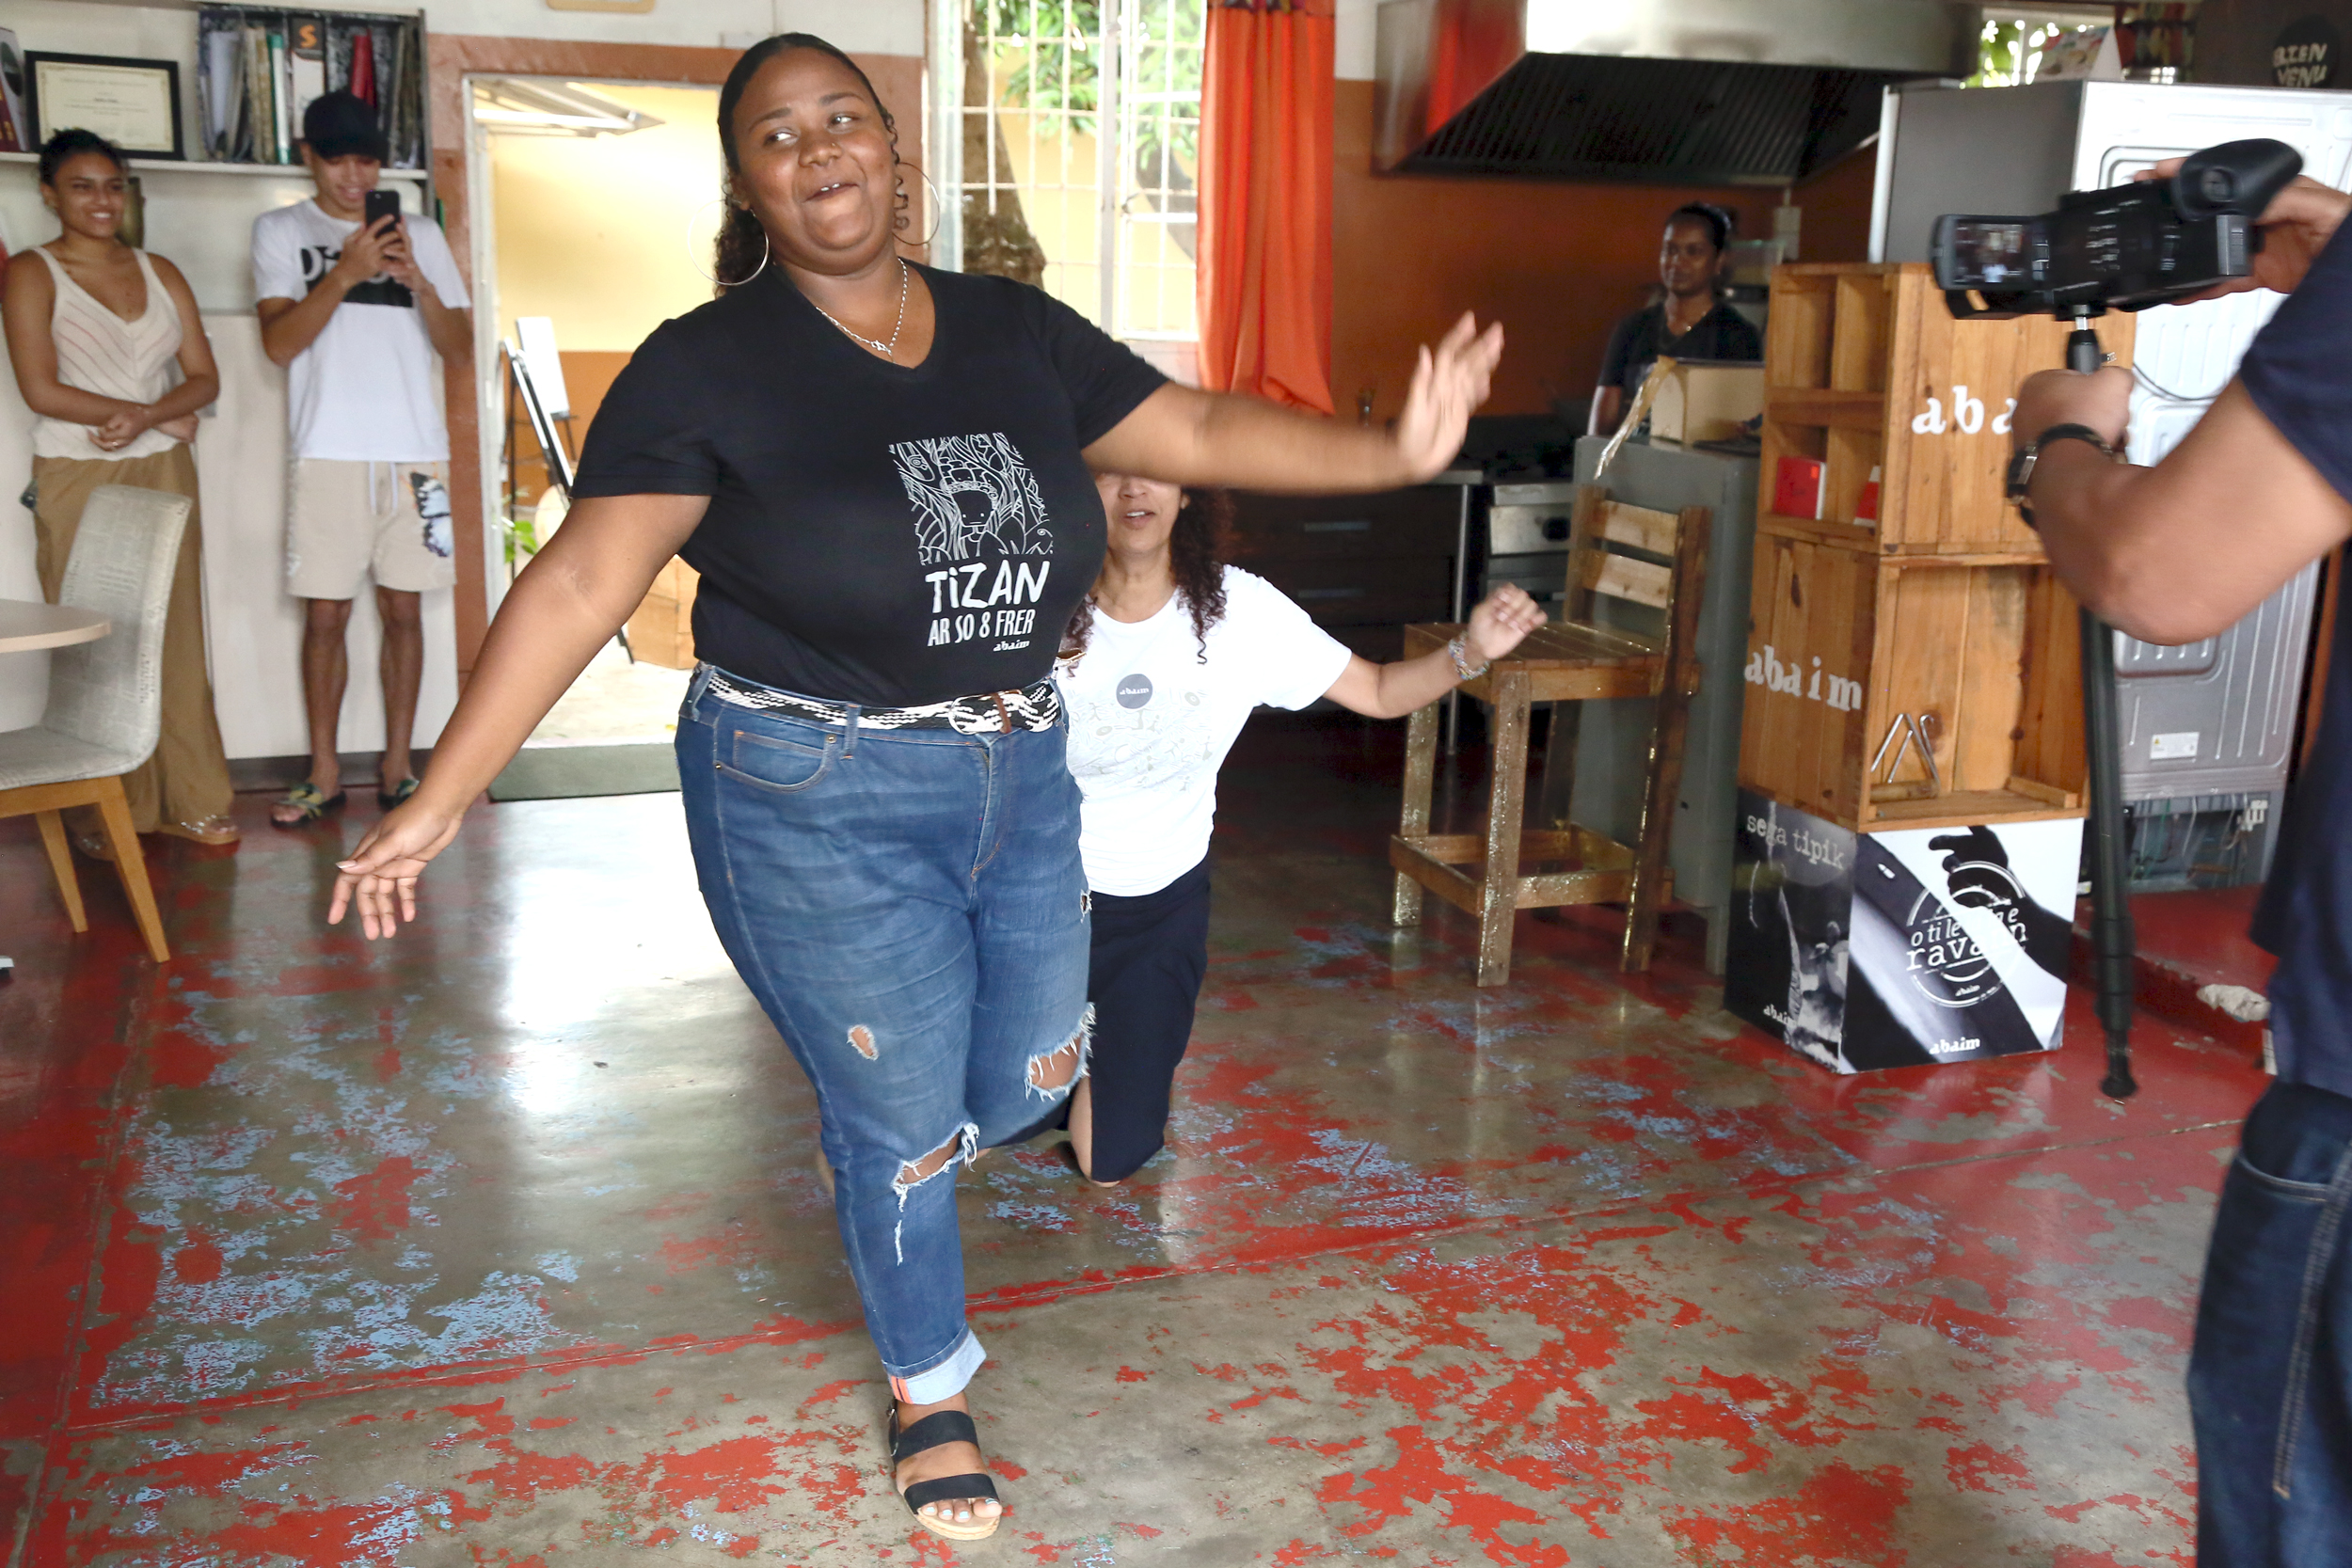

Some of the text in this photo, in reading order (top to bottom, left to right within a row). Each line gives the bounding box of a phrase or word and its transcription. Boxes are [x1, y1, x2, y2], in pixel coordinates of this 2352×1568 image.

[2273, 42, 2328, 68] BIEN
[1912, 385, 2018, 435] aba
[927, 609, 1036, 647] AR SO 8 FRER
[993, 639, 1030, 652] abaim
[1744, 643, 1862, 712] abaim
[1792, 829, 1844, 871] tipik
[1763, 1004, 1797, 1029] abai
[1929, 1036, 1981, 1054] abaim
